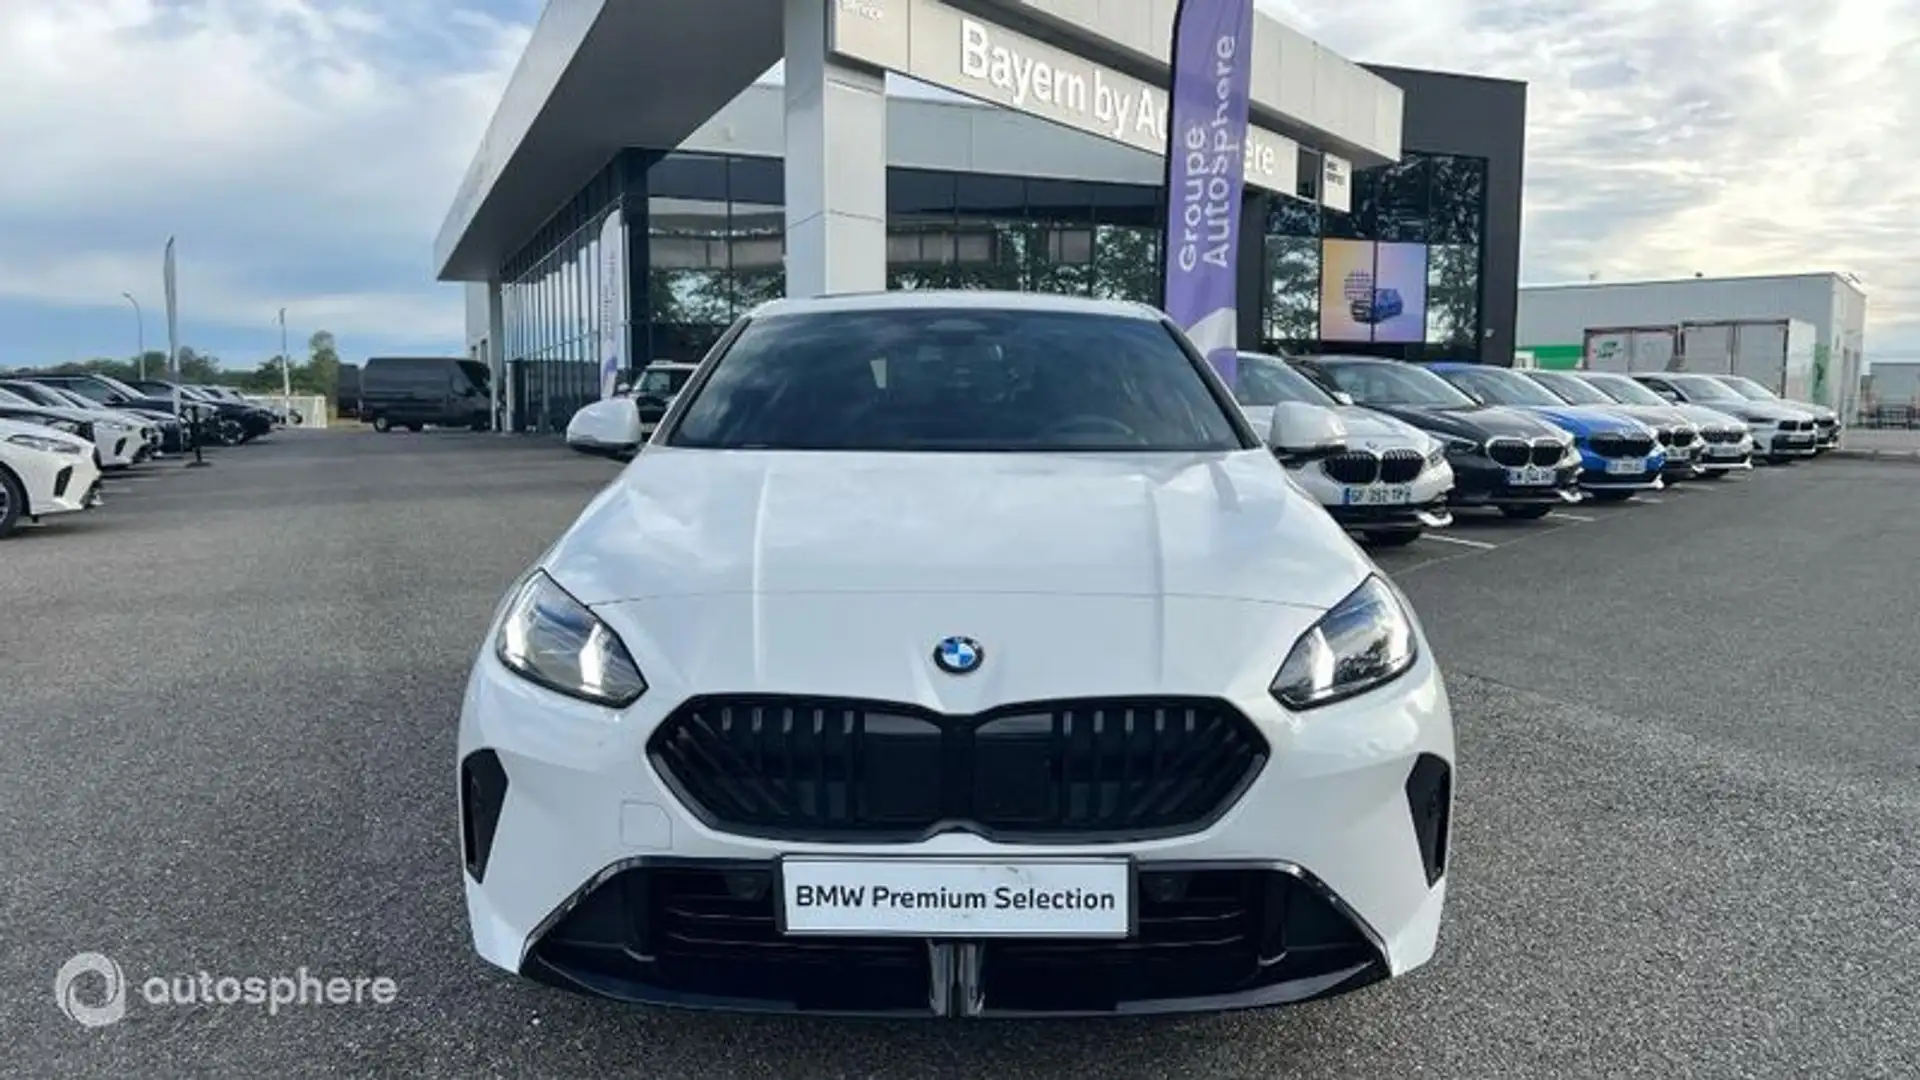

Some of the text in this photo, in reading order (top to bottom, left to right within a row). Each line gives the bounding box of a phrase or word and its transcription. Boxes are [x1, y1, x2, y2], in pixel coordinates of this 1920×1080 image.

[961, 18, 1086, 111] Bayern
[1094, 69, 1129, 138] by
[1178, 125, 1209, 273] Groupe
[796, 885, 1115, 910] BMW Premium Selection
